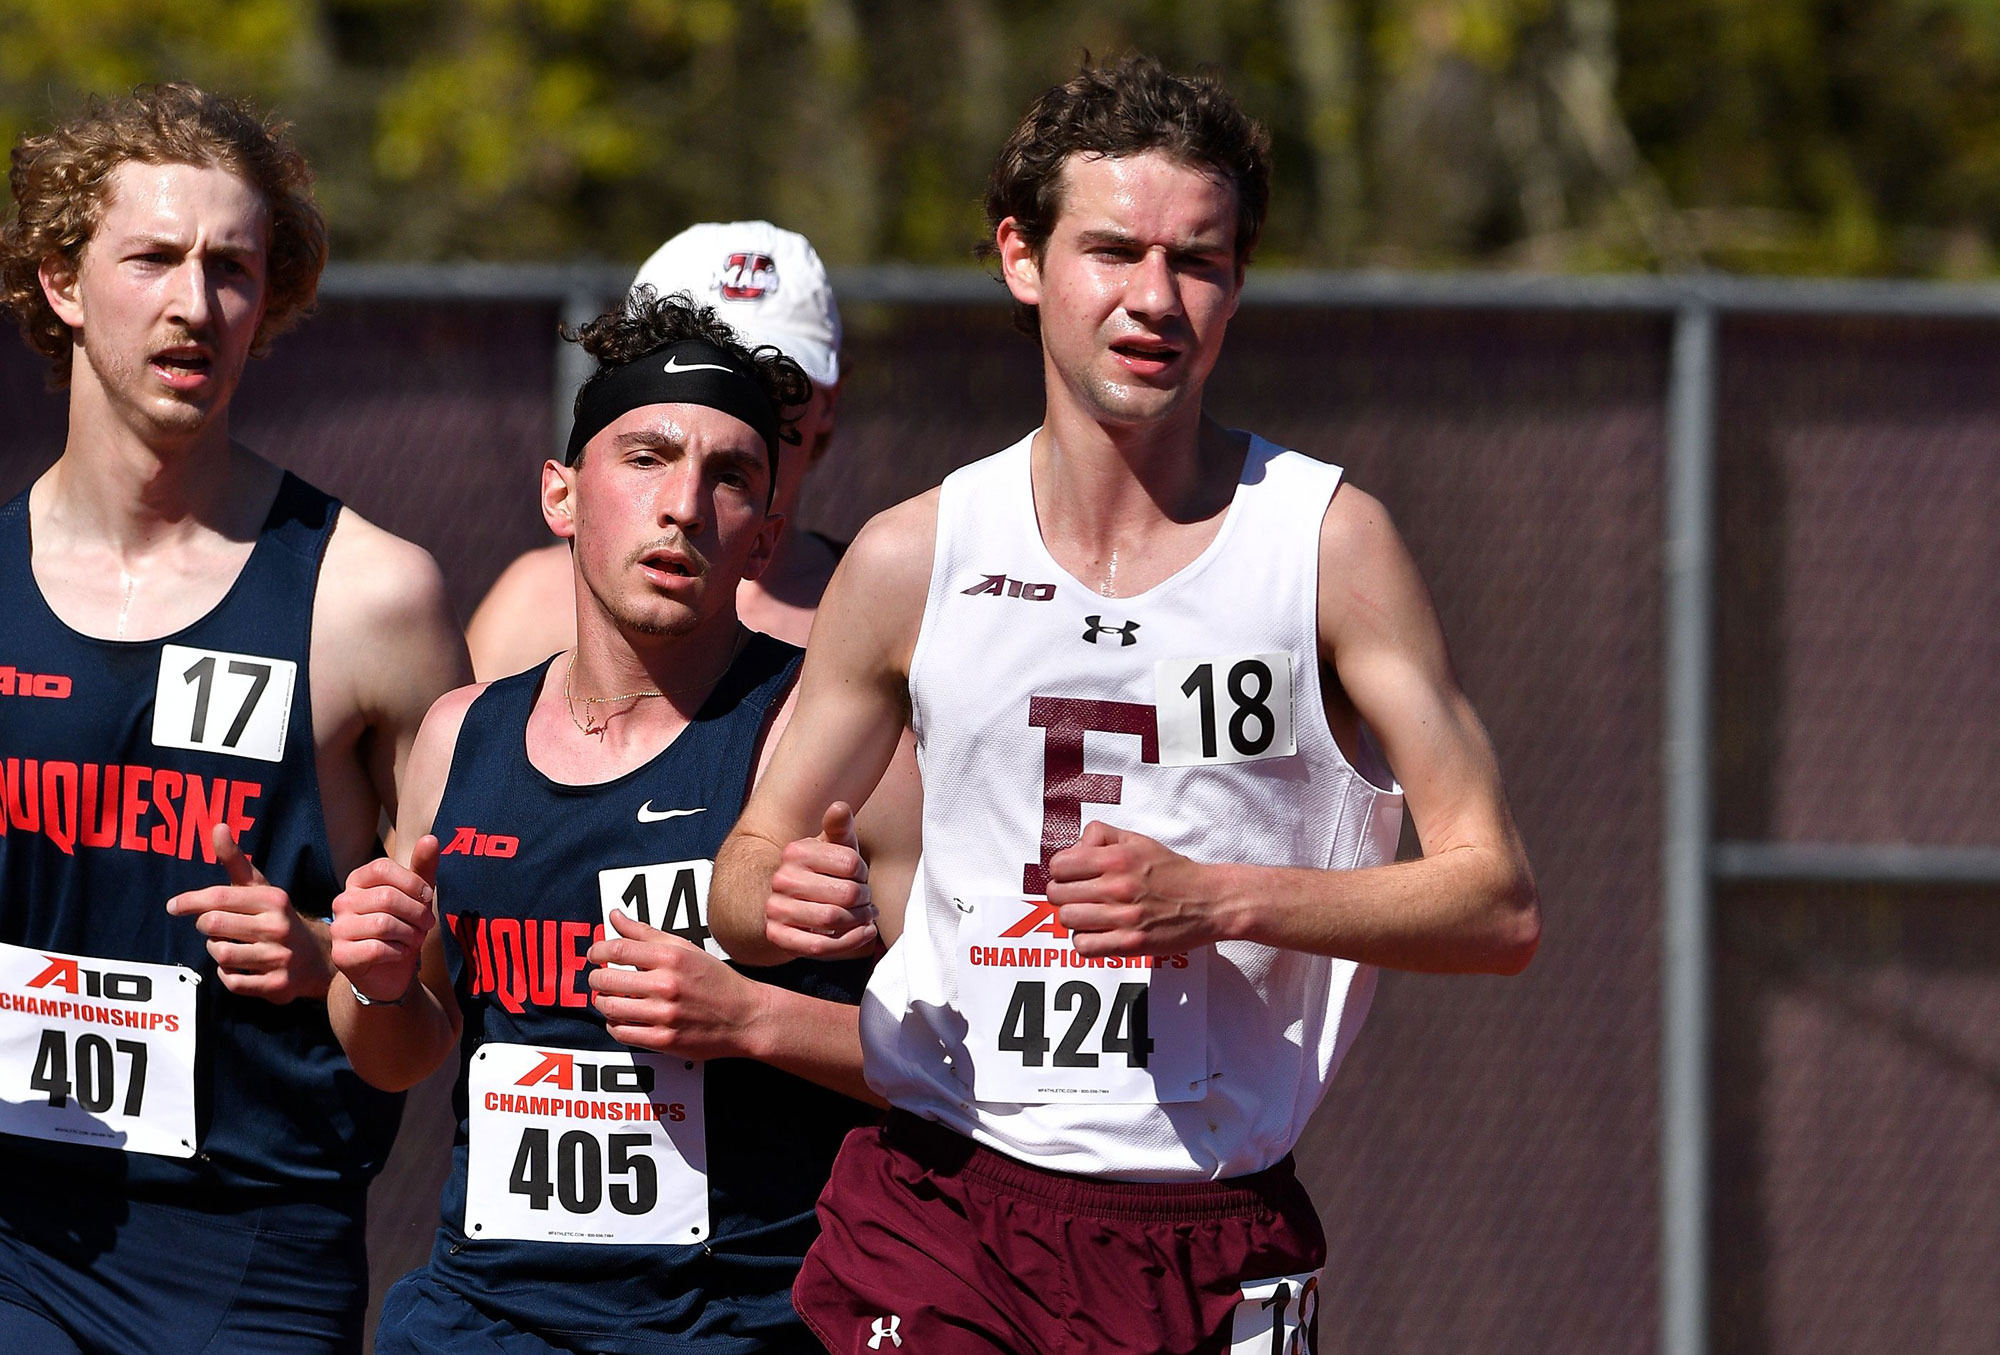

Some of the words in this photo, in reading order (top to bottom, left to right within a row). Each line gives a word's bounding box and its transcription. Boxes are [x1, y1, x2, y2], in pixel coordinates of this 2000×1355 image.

[961, 574, 1057, 601] A10
[183, 656, 272, 748] 17
[1181, 660, 1275, 756] 18
[0, 757, 262, 865] UQUESNE
[1023, 695, 1160, 894] F
[441, 827, 519, 858] A10
[25, 955, 152, 1002] A10
[969, 945, 1189, 969] CHAMPIONSHIPS
[0, 992, 179, 1032] CHAMPIONSHIPS
[998, 980, 1155, 1068] 424
[30, 1028, 148, 1117] 407
[513, 1050, 655, 1093] A10
[484, 1092, 687, 1122] CHAMPIONSHIPS
[509, 1127, 657, 1215] 405
